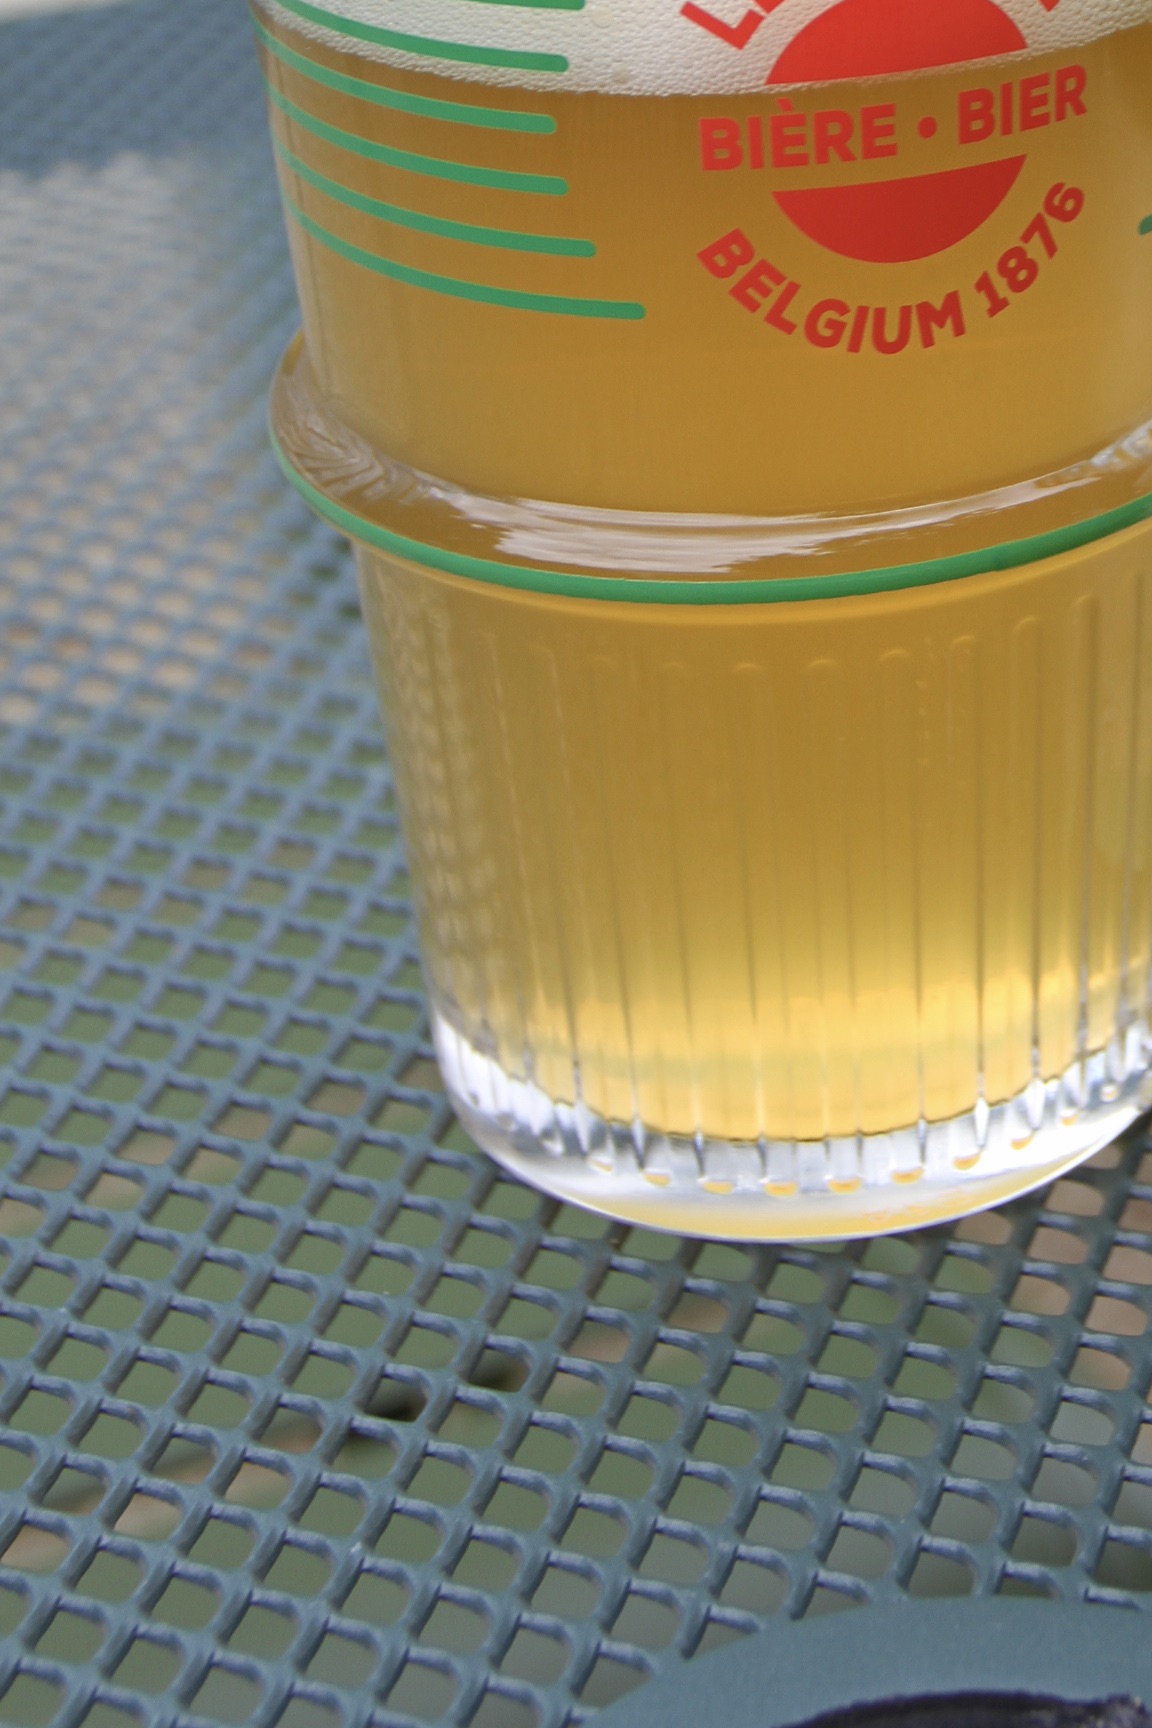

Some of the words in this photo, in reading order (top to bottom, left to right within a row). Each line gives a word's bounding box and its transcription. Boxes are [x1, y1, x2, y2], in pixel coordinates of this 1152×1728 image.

[698, 98, 898, 172] BIÈRE
[957, 64, 1088, 145] BIER
[696, 228, 967, 355] BELGIUM
[973, 182, 1086, 319] 1876
